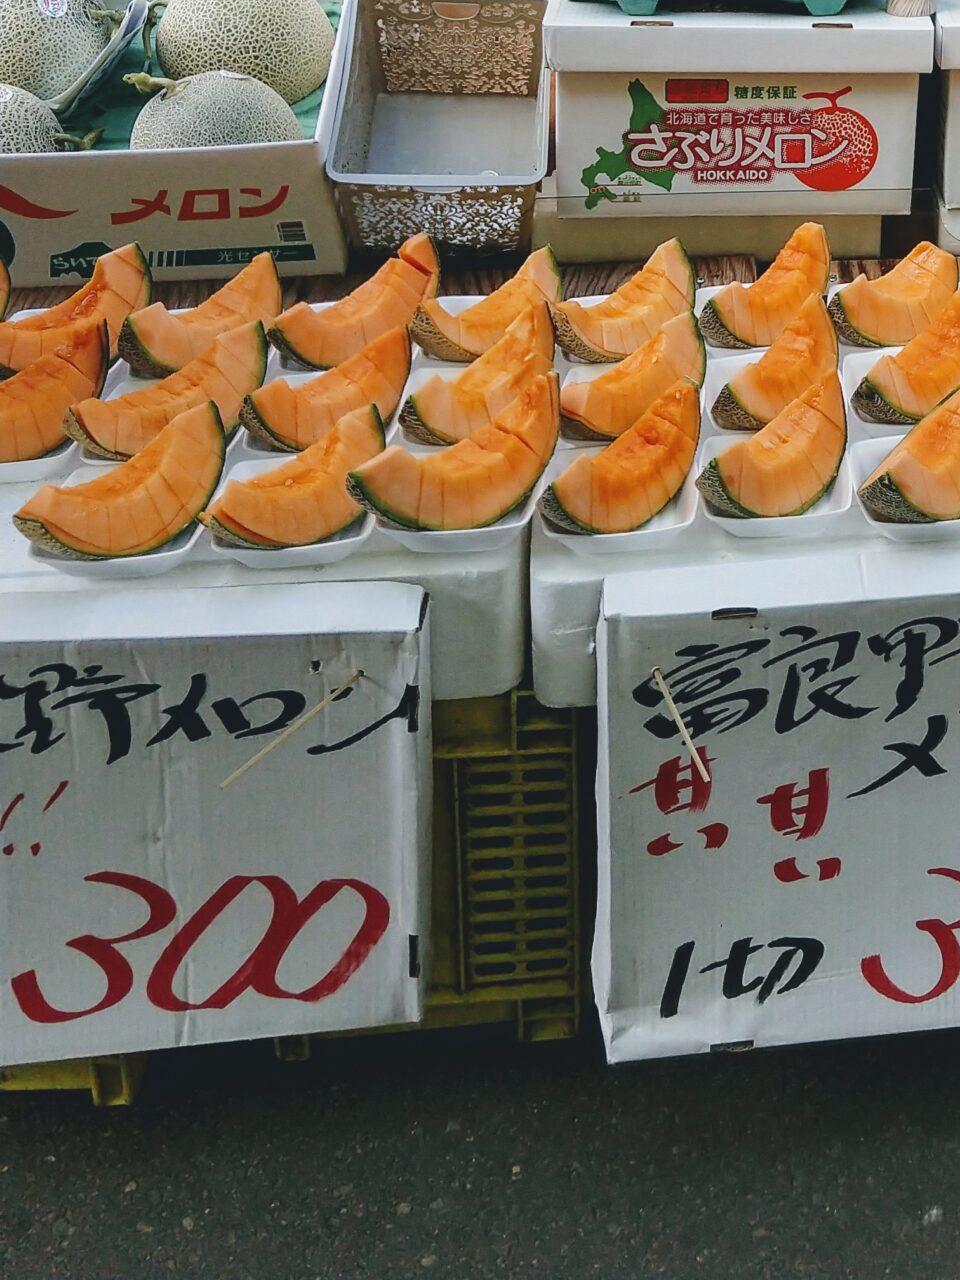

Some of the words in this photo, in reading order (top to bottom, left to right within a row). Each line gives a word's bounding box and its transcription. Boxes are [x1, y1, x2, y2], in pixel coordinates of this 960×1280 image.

[734, 85, 798, 100] 糖度保証
[666, 111, 813, 126] 北海道で育った美味しさ
[628, 123, 849, 169] さぶりメロン
[697, 169, 769, 181] HOKKAIDO
[110, 184, 290, 226] メロン
[10, 870, 391, 1024] 300
